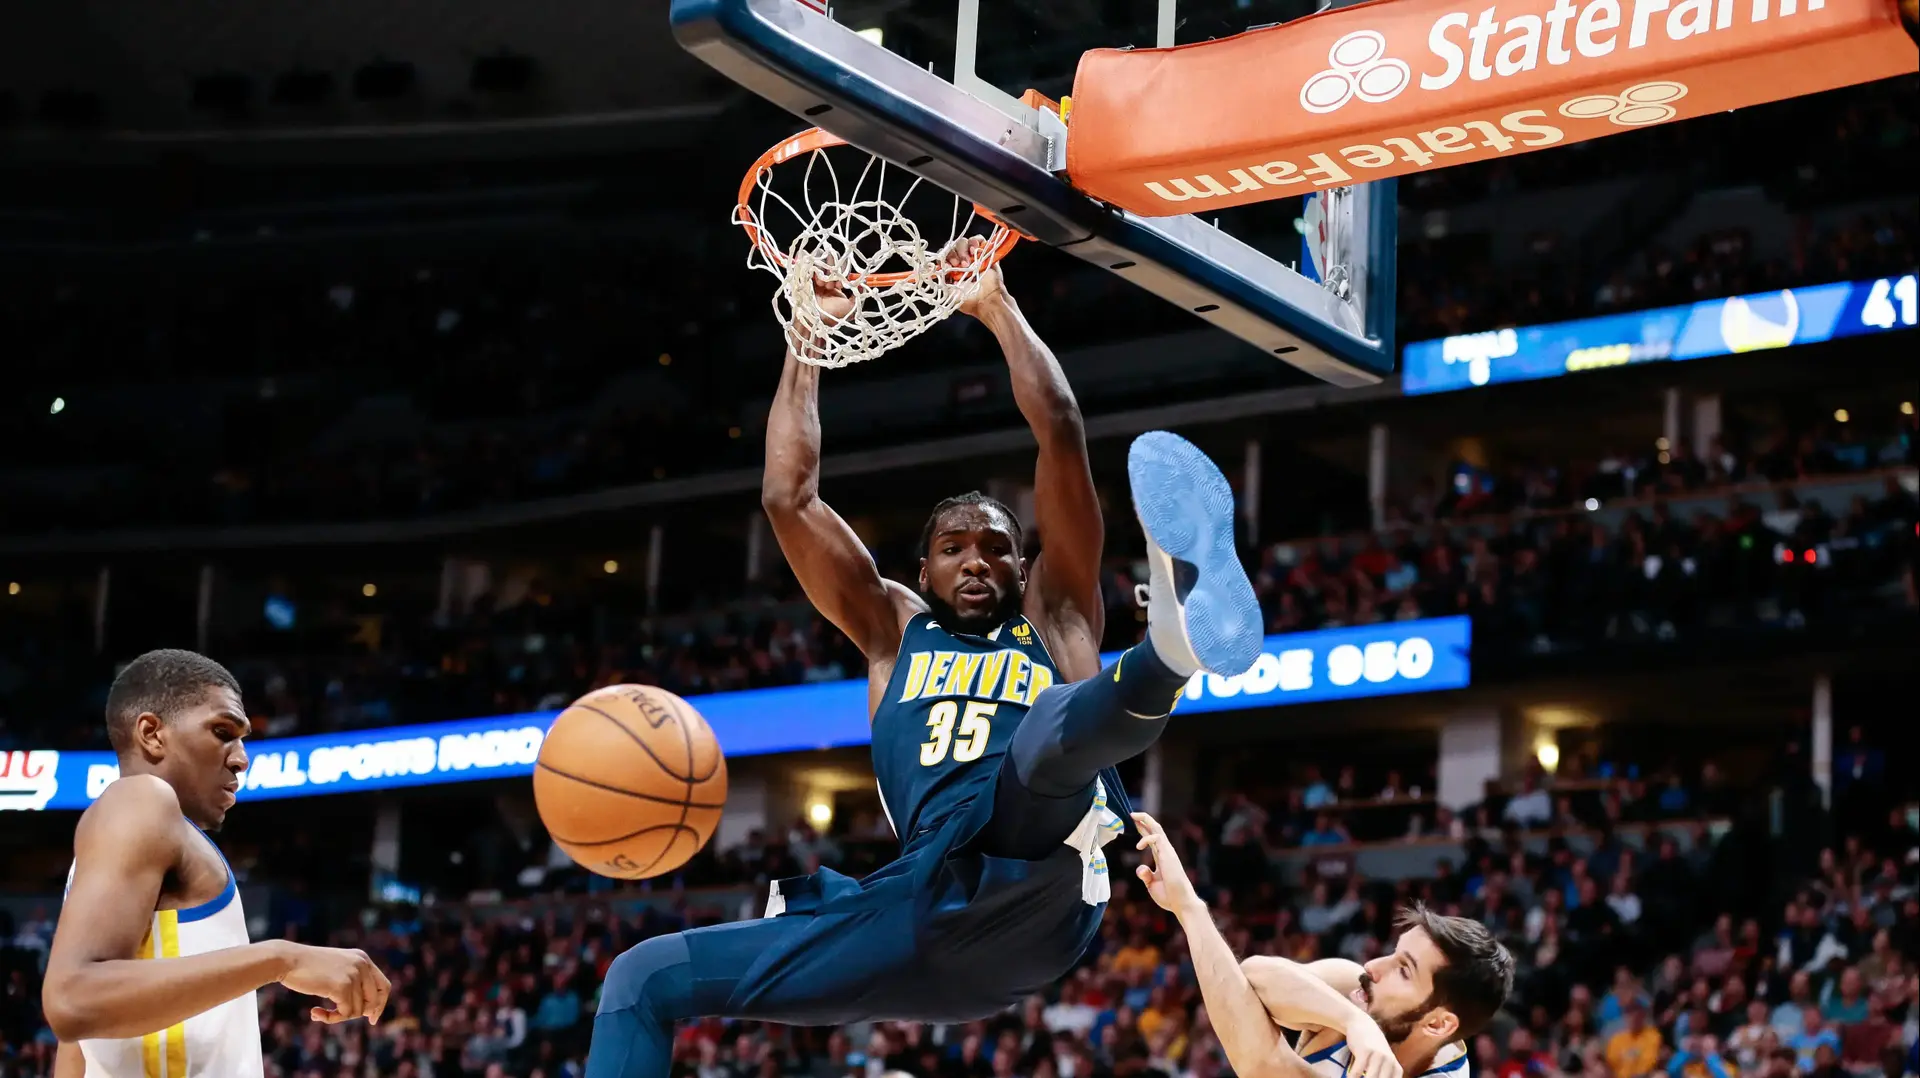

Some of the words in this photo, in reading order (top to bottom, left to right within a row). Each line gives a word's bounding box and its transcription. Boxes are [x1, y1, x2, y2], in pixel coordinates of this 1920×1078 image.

[1861, 275, 1917, 328] 41
[897, 648, 1054, 707] DENVER
[1328, 637, 1433, 686] 950
[246, 751, 307, 790] ALL
[308, 737, 437, 785] SPORTS
[437, 726, 545, 772] RADIO
[919, 700, 998, 767] 35
